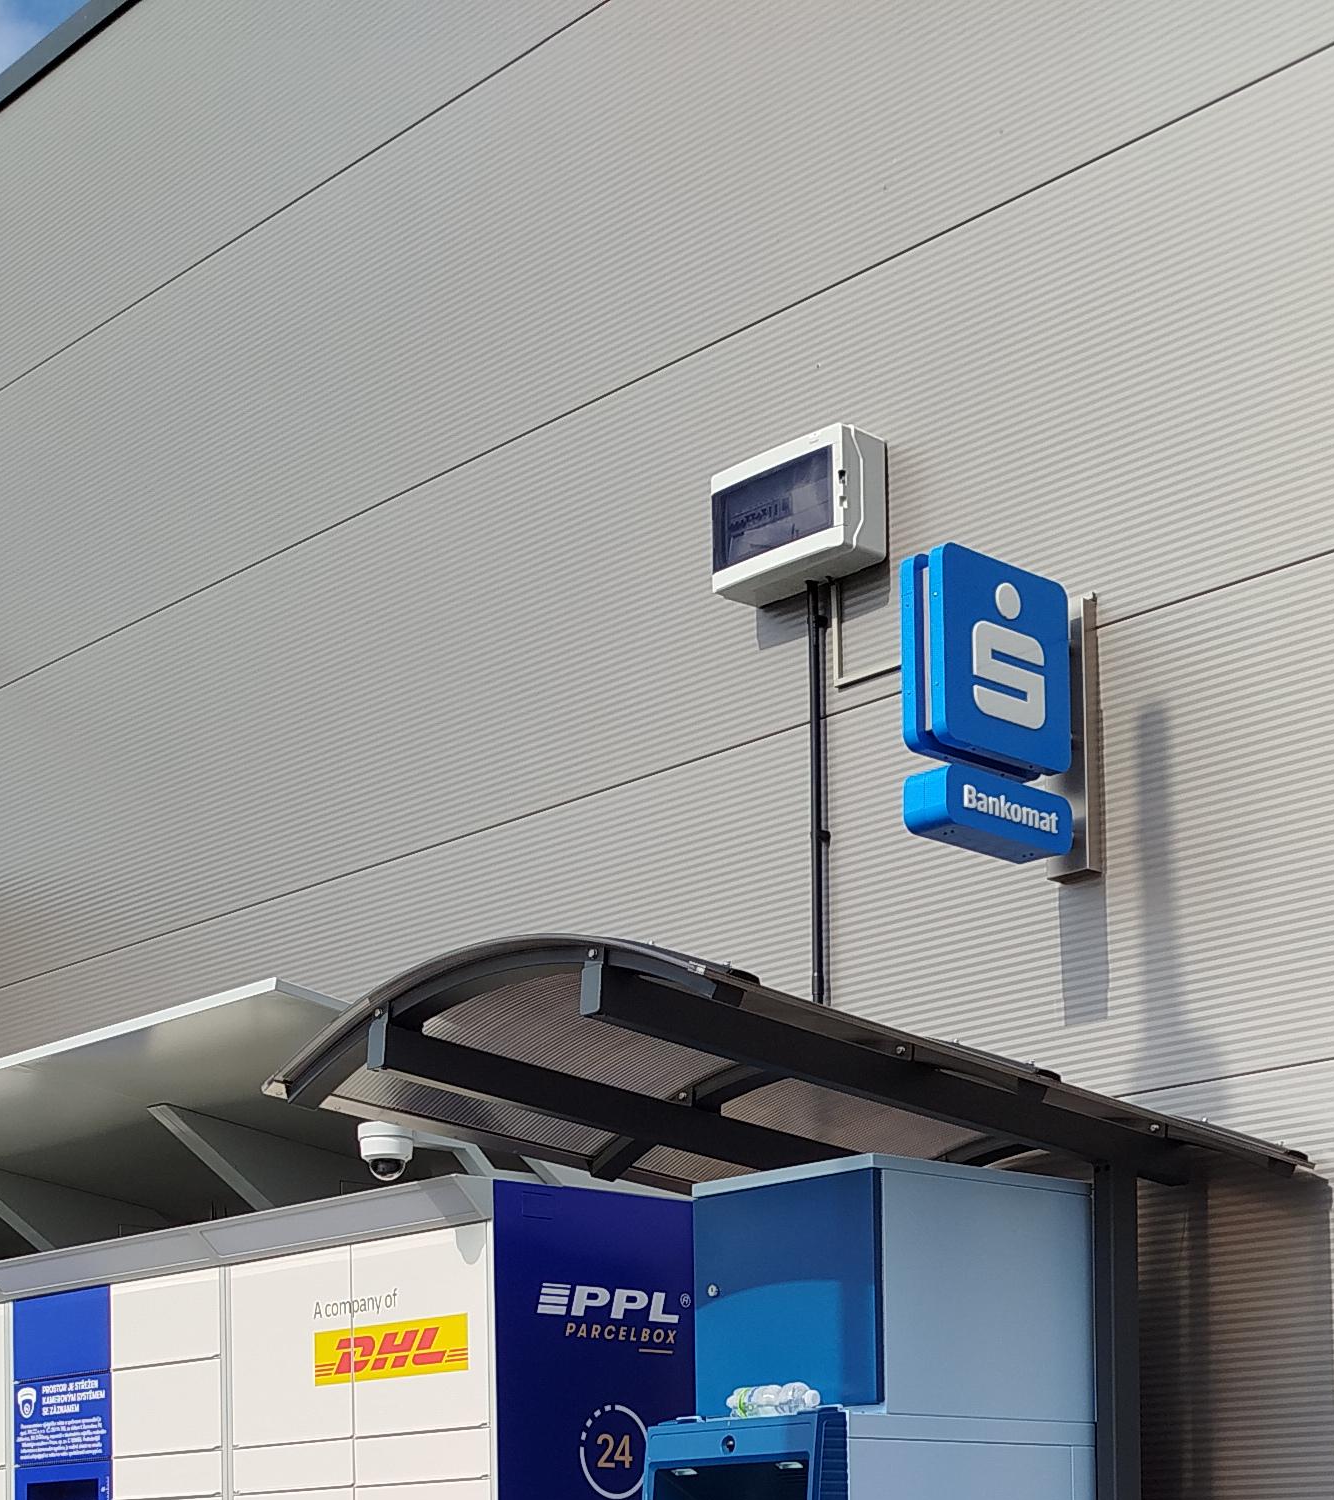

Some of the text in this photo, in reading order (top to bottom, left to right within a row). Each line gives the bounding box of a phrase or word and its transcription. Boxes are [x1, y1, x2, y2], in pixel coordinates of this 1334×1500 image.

[962, 784, 1060, 836] Bankomat
[313, 1288, 398, 1320] A company of
[333, 1326, 448, 1376] DHL
[565, 1322, 678, 1345] PARCELBOX
[596, 1433, 634, 1470] 24
